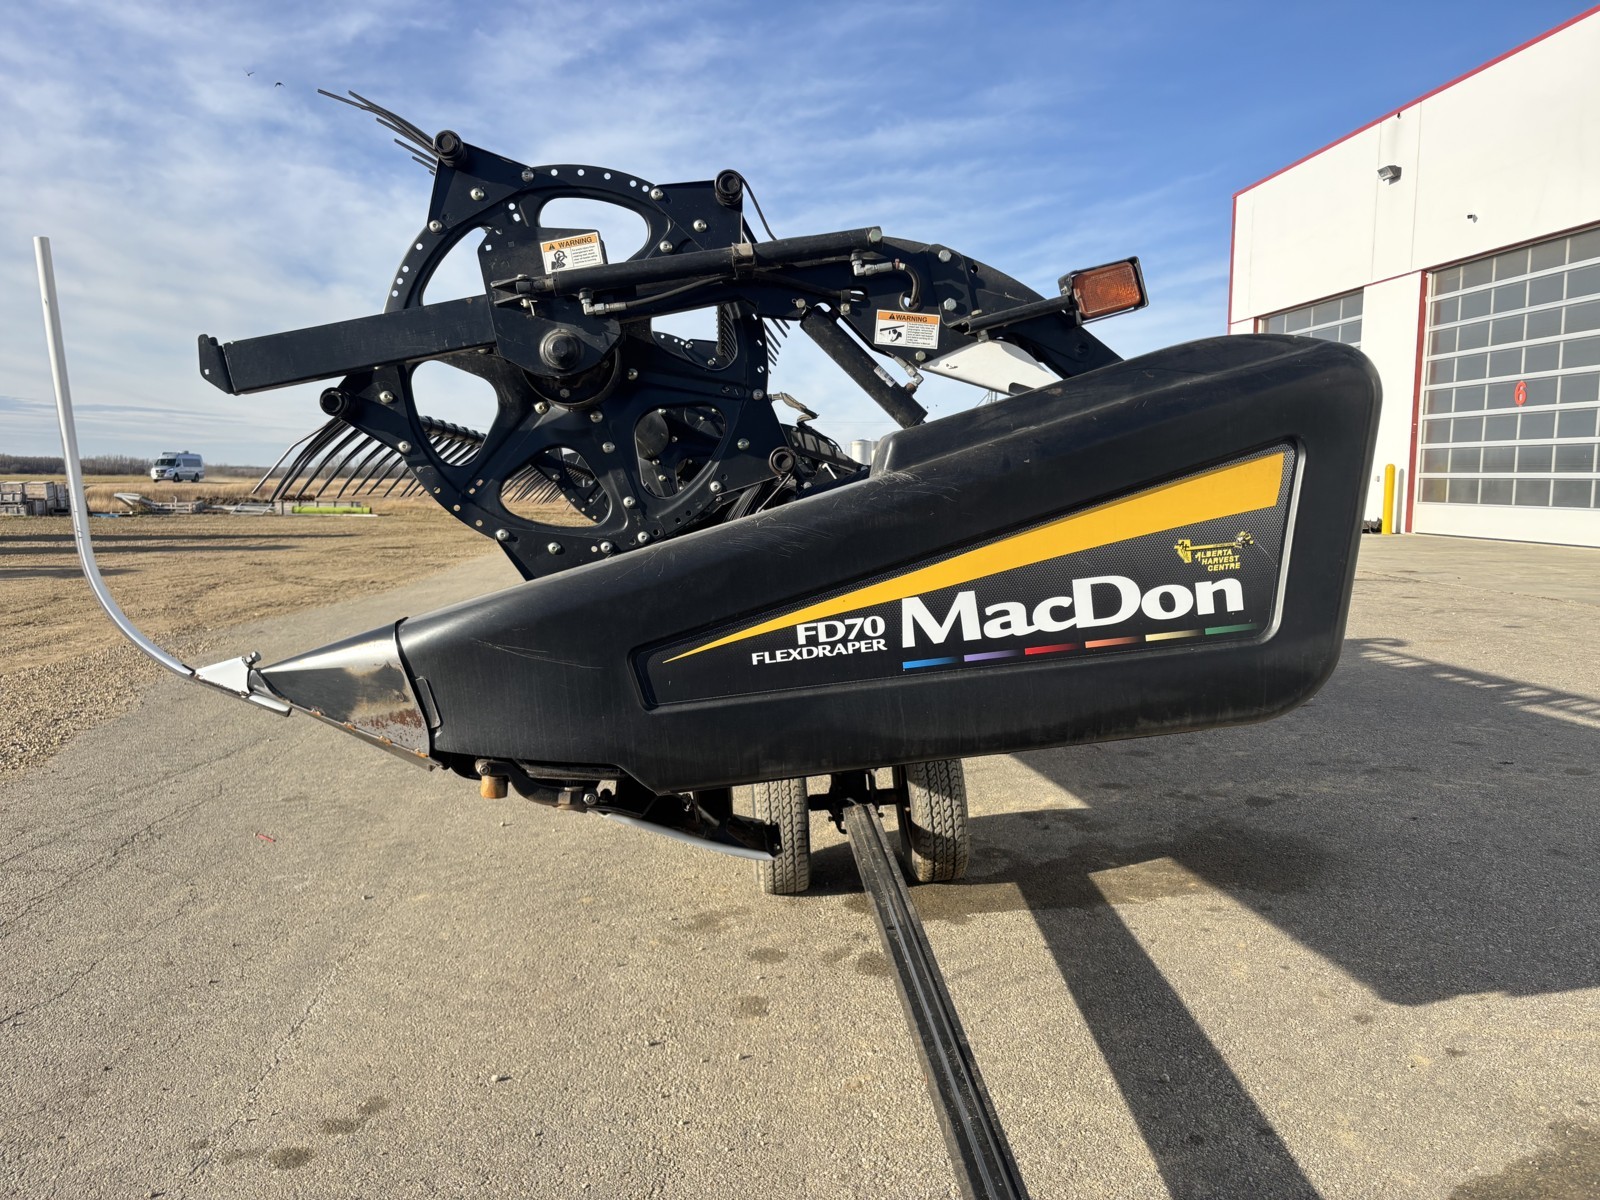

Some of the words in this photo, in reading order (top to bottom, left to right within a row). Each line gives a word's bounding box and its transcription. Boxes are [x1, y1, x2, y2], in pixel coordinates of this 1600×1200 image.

[558, 236, 593, 248] WARNING
[896, 314, 928, 323] WARNING
[1515, 380, 1527, 406] 6
[1195, 549, 1232, 561] ALBERTA
[1201, 555, 1240, 566] HARVEST
[1207, 562, 1241, 572] CENTRE
[901, 575, 1245, 649] MacDon
[796, 615, 886, 646] FD70
[751, 638, 888, 666] FLEXDRAPER
